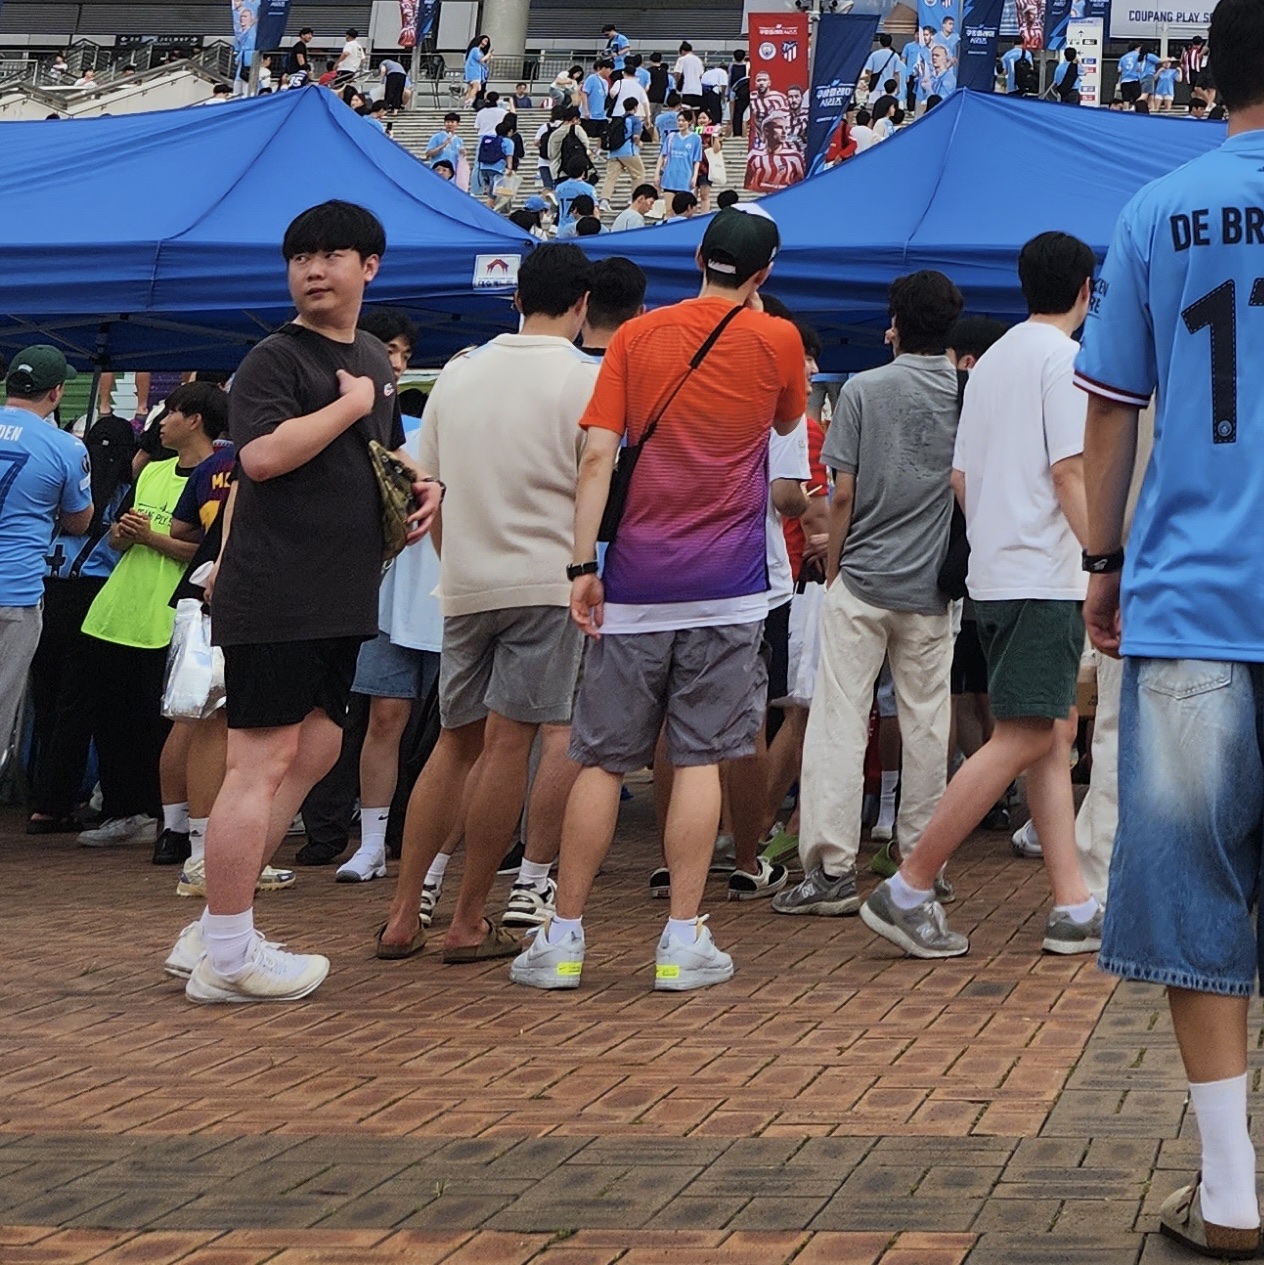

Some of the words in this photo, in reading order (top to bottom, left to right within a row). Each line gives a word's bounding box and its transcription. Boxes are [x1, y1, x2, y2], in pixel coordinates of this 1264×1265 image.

[1129, 10, 1173, 23] COUPANG
[1176, 11, 1200, 23] PLAY
[1170, 209, 1210, 251] DE
